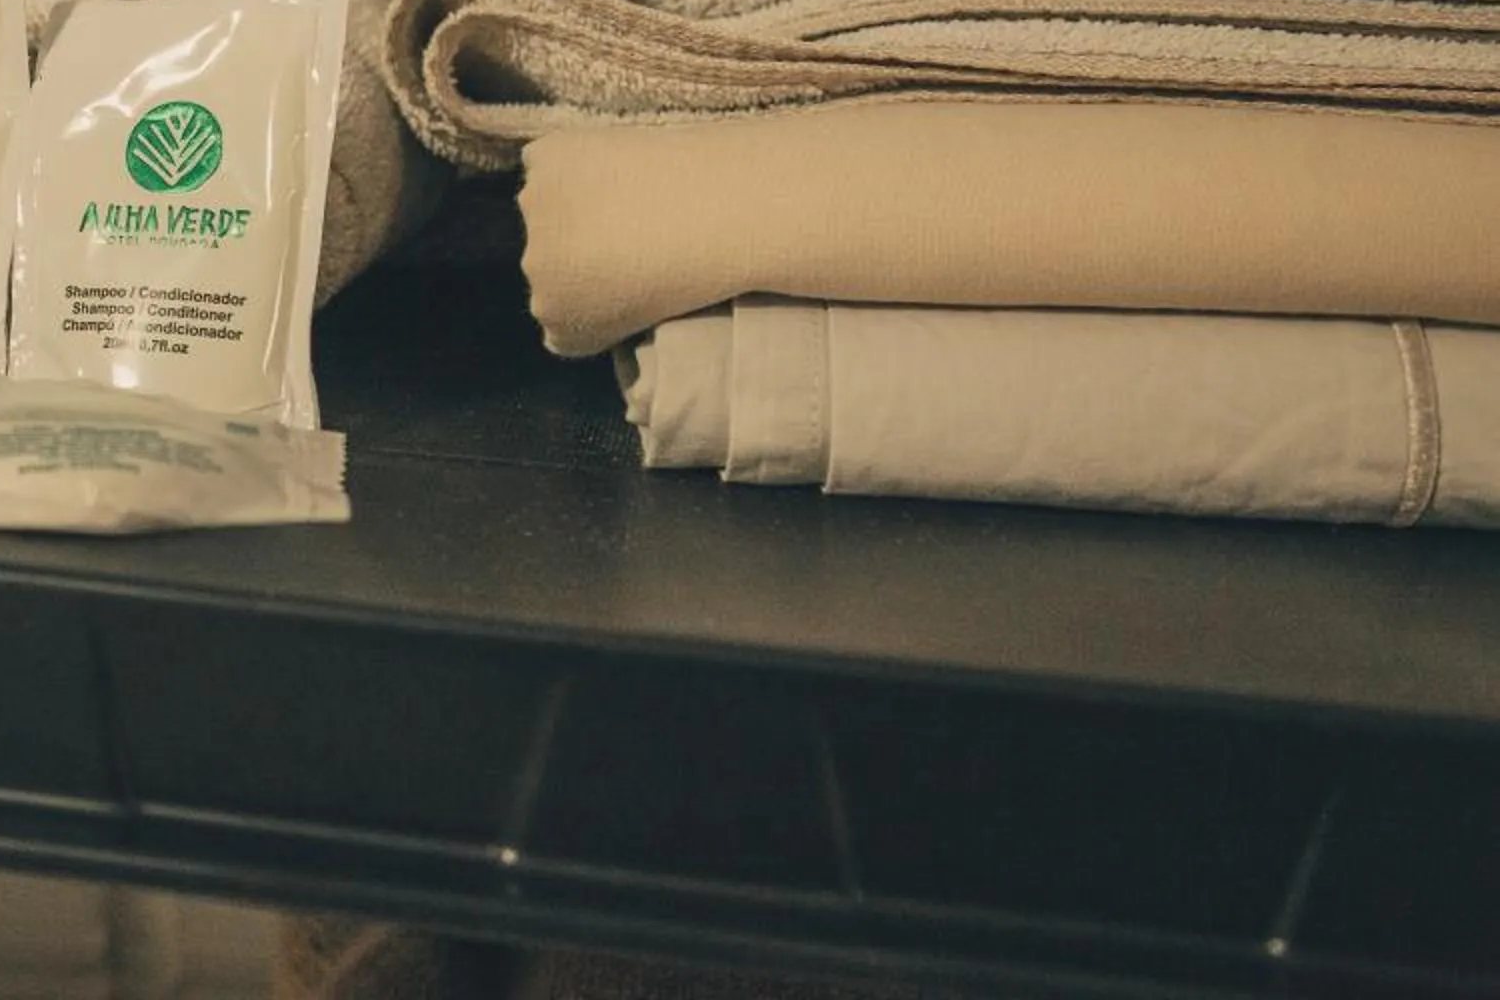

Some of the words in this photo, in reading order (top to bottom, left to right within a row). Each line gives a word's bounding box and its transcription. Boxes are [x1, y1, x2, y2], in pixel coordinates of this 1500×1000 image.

[167, 205, 252, 239] VERDE
[64, 284, 128, 301] Shampoo
[138, 286, 248, 307] Condicionador
[71, 301, 135, 317] Shampoo
[147, 303, 235, 323] Conditioner
